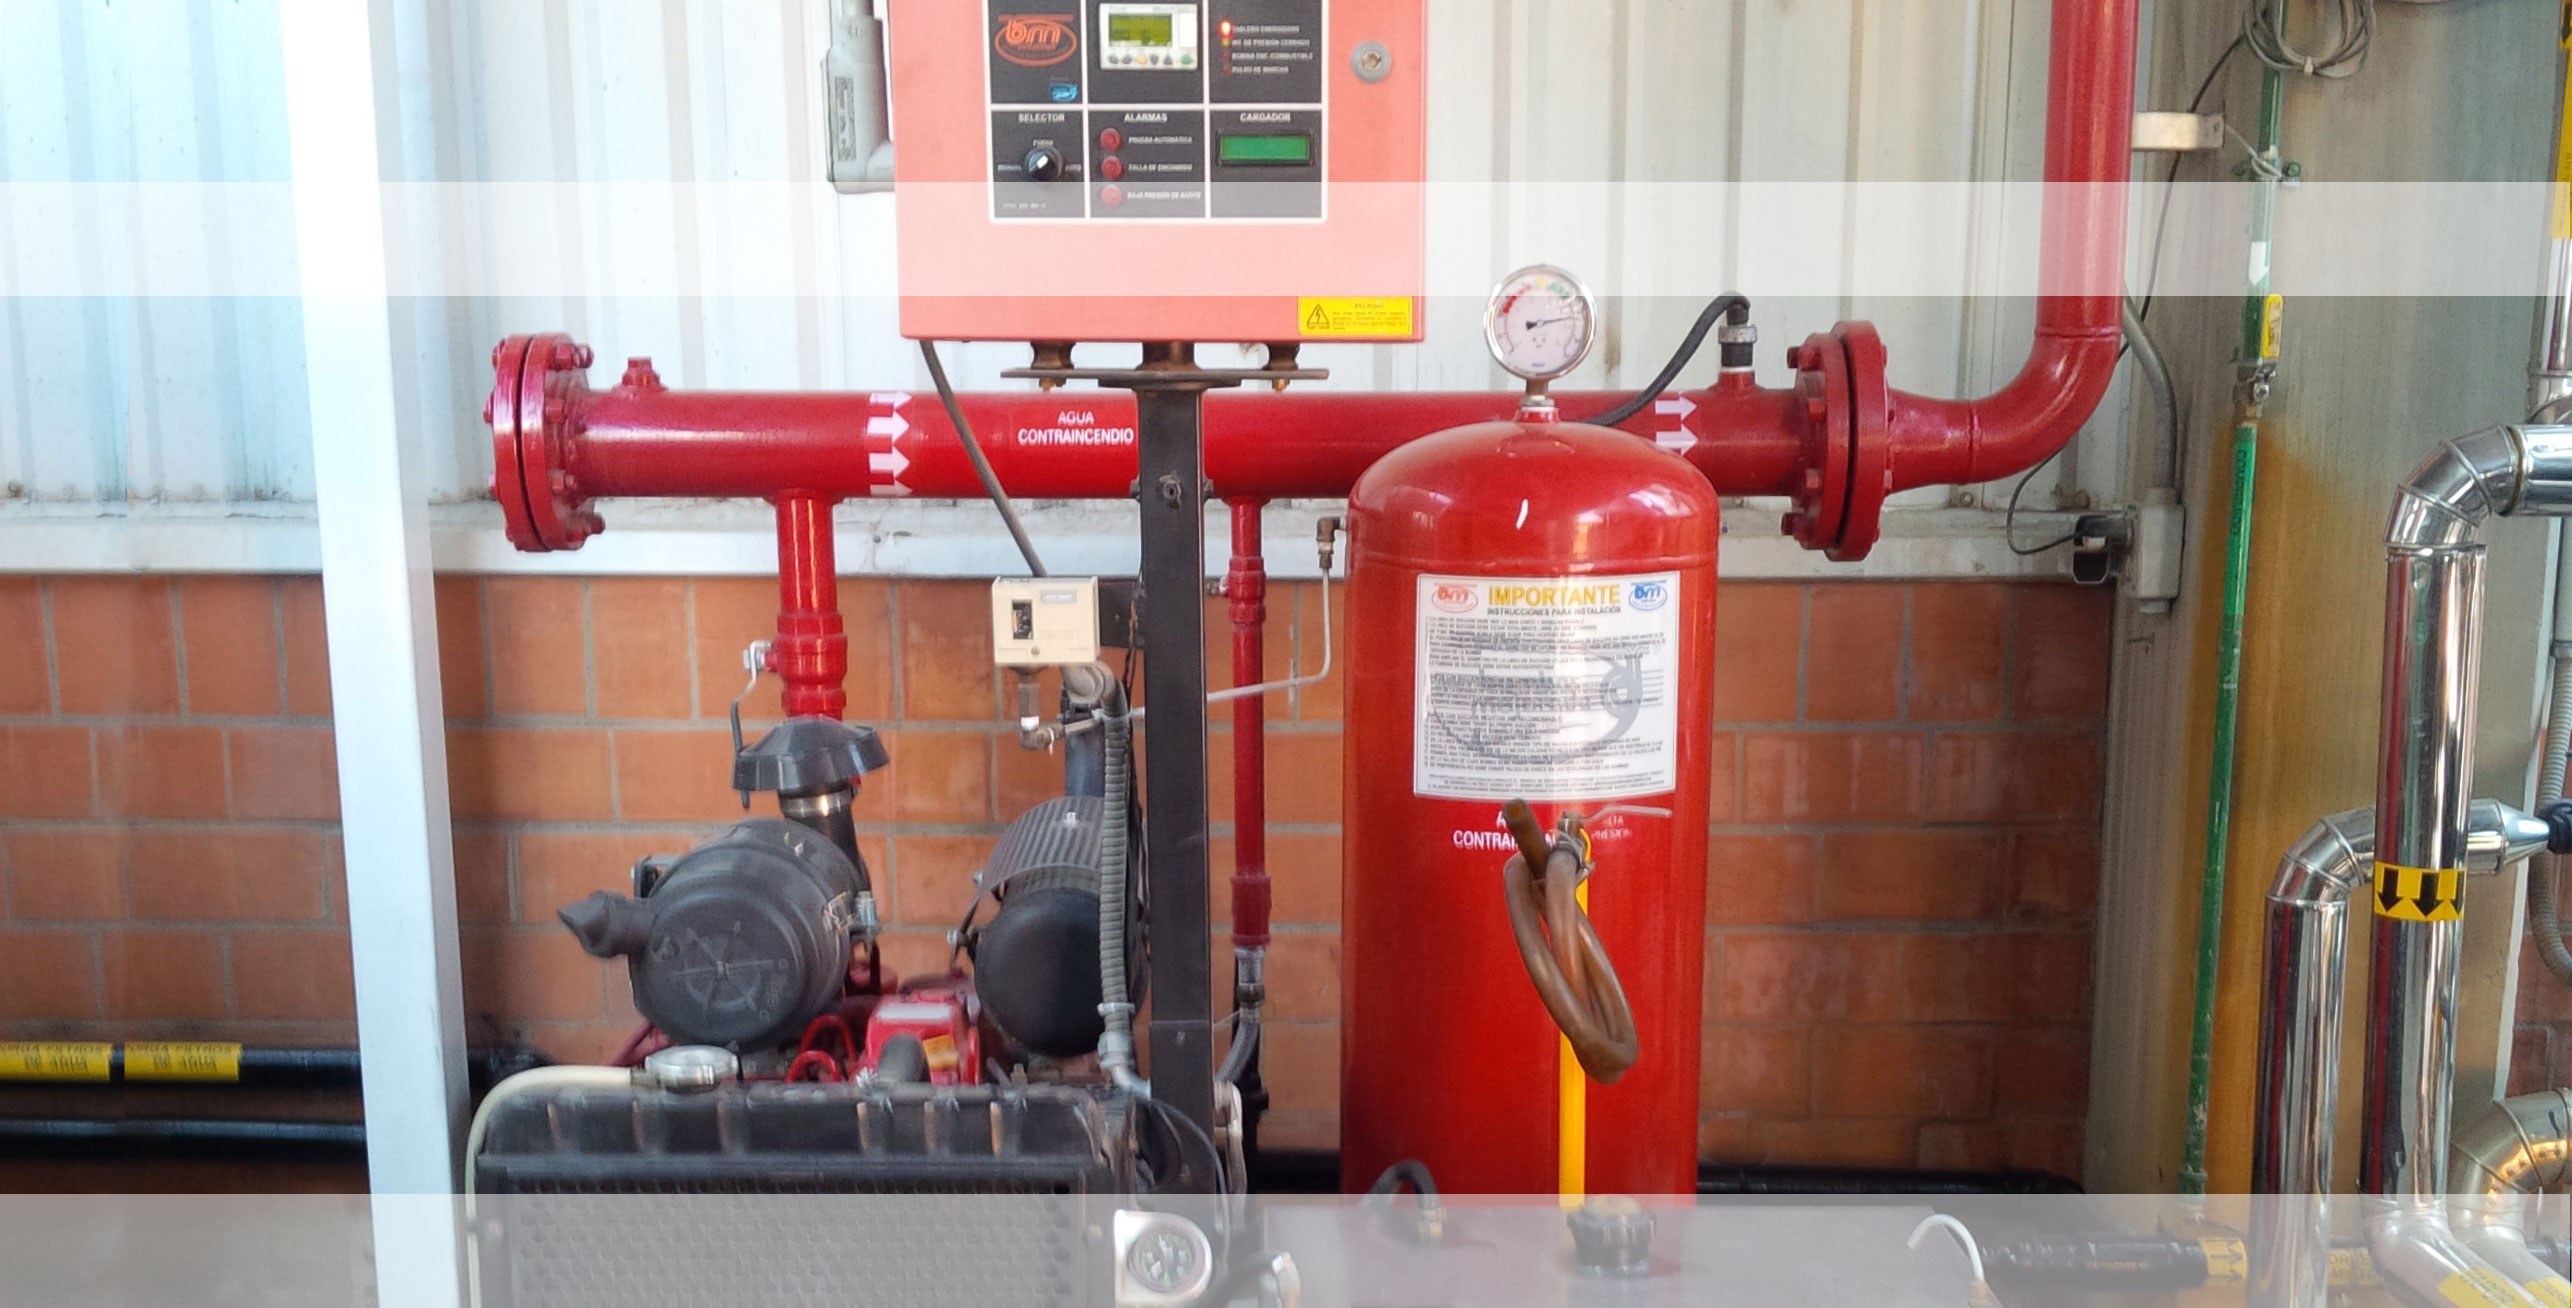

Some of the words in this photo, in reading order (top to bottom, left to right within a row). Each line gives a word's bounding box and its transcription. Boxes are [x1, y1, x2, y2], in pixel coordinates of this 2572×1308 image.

[1018, 113, 1065, 123] SELECTOR
[1124, 112, 1168, 123] ALARMAS
[1239, 112, 1291, 123] CARGADOR
[1057, 410, 1095, 426] AGUA
[1018, 427, 1135, 446] CONTRAINCENDIO
[1487, 583, 1621, 607] IMPORTANTE
[1487, 607, 1550, 617] INSTRUCCIONES
[1551, 607, 1572, 616] PARA
[1573, 604, 1621, 616] INSTALACIÓN
